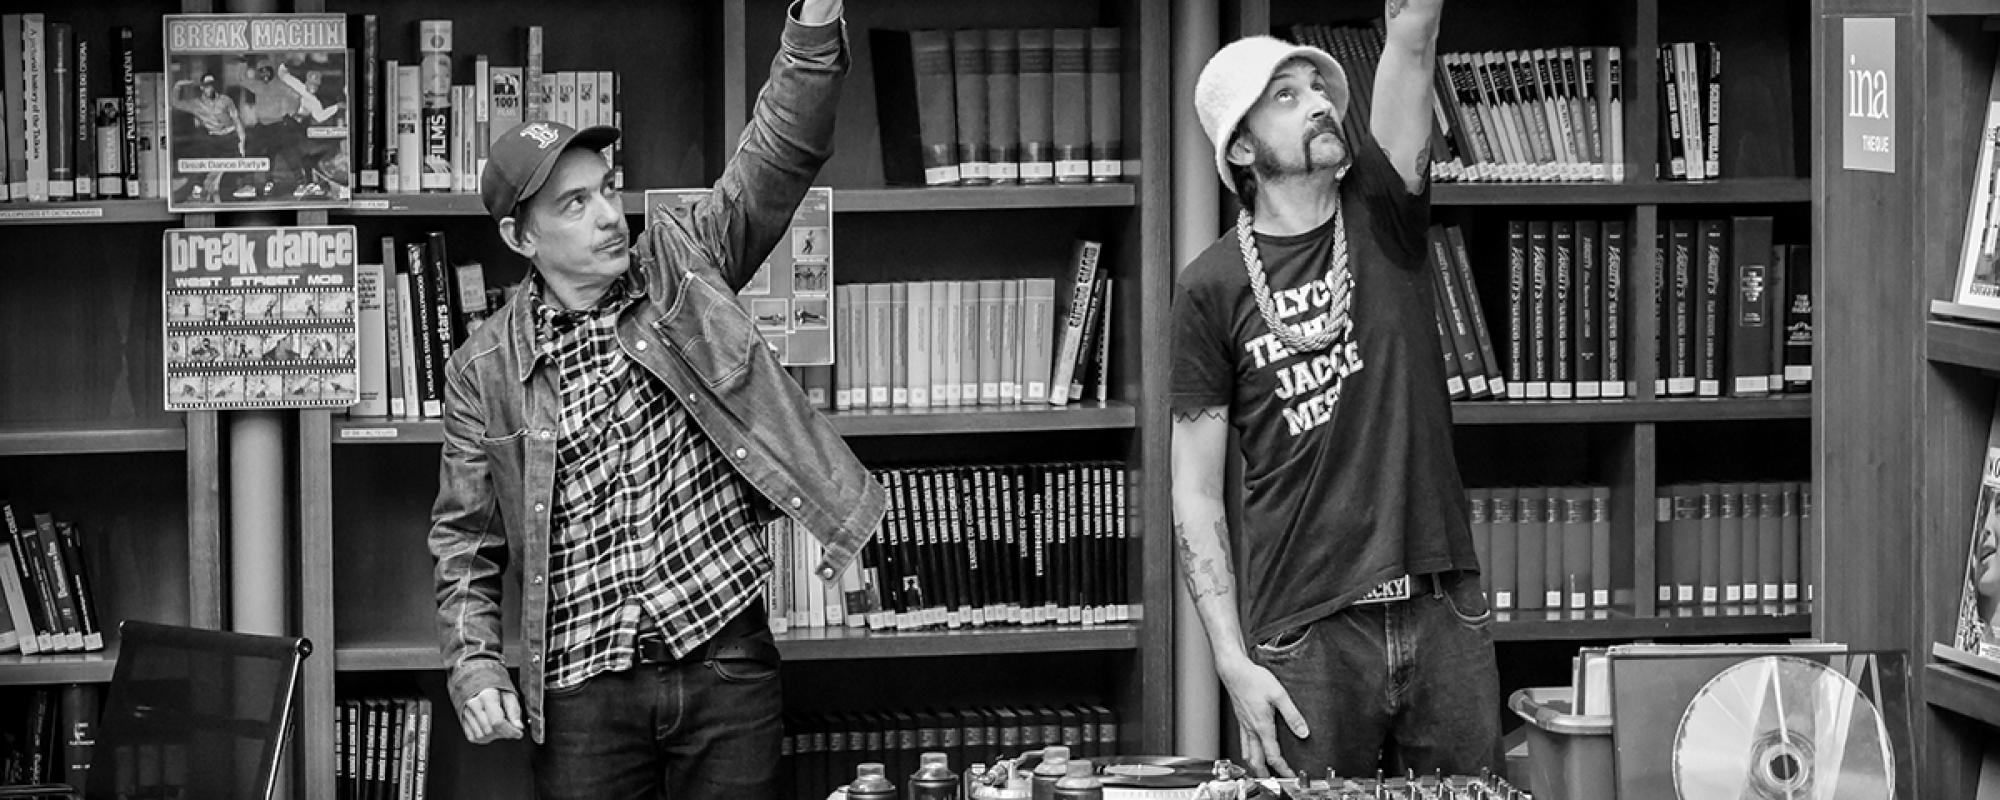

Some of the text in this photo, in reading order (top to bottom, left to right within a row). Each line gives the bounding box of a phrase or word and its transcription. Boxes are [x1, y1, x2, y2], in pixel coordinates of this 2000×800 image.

[171, 20, 346, 50] BREAK MACHIN
[1849, 54, 1889, 119] ina
[494, 97, 518, 108] 1001
[208, 160, 235, 169] Dance
[171, 229, 353, 274] break dance
[175, 274, 344, 288] WEST STREET MOB
[1273, 270, 1352, 319] LYC
[1368, 578, 1405, 598] CKY
